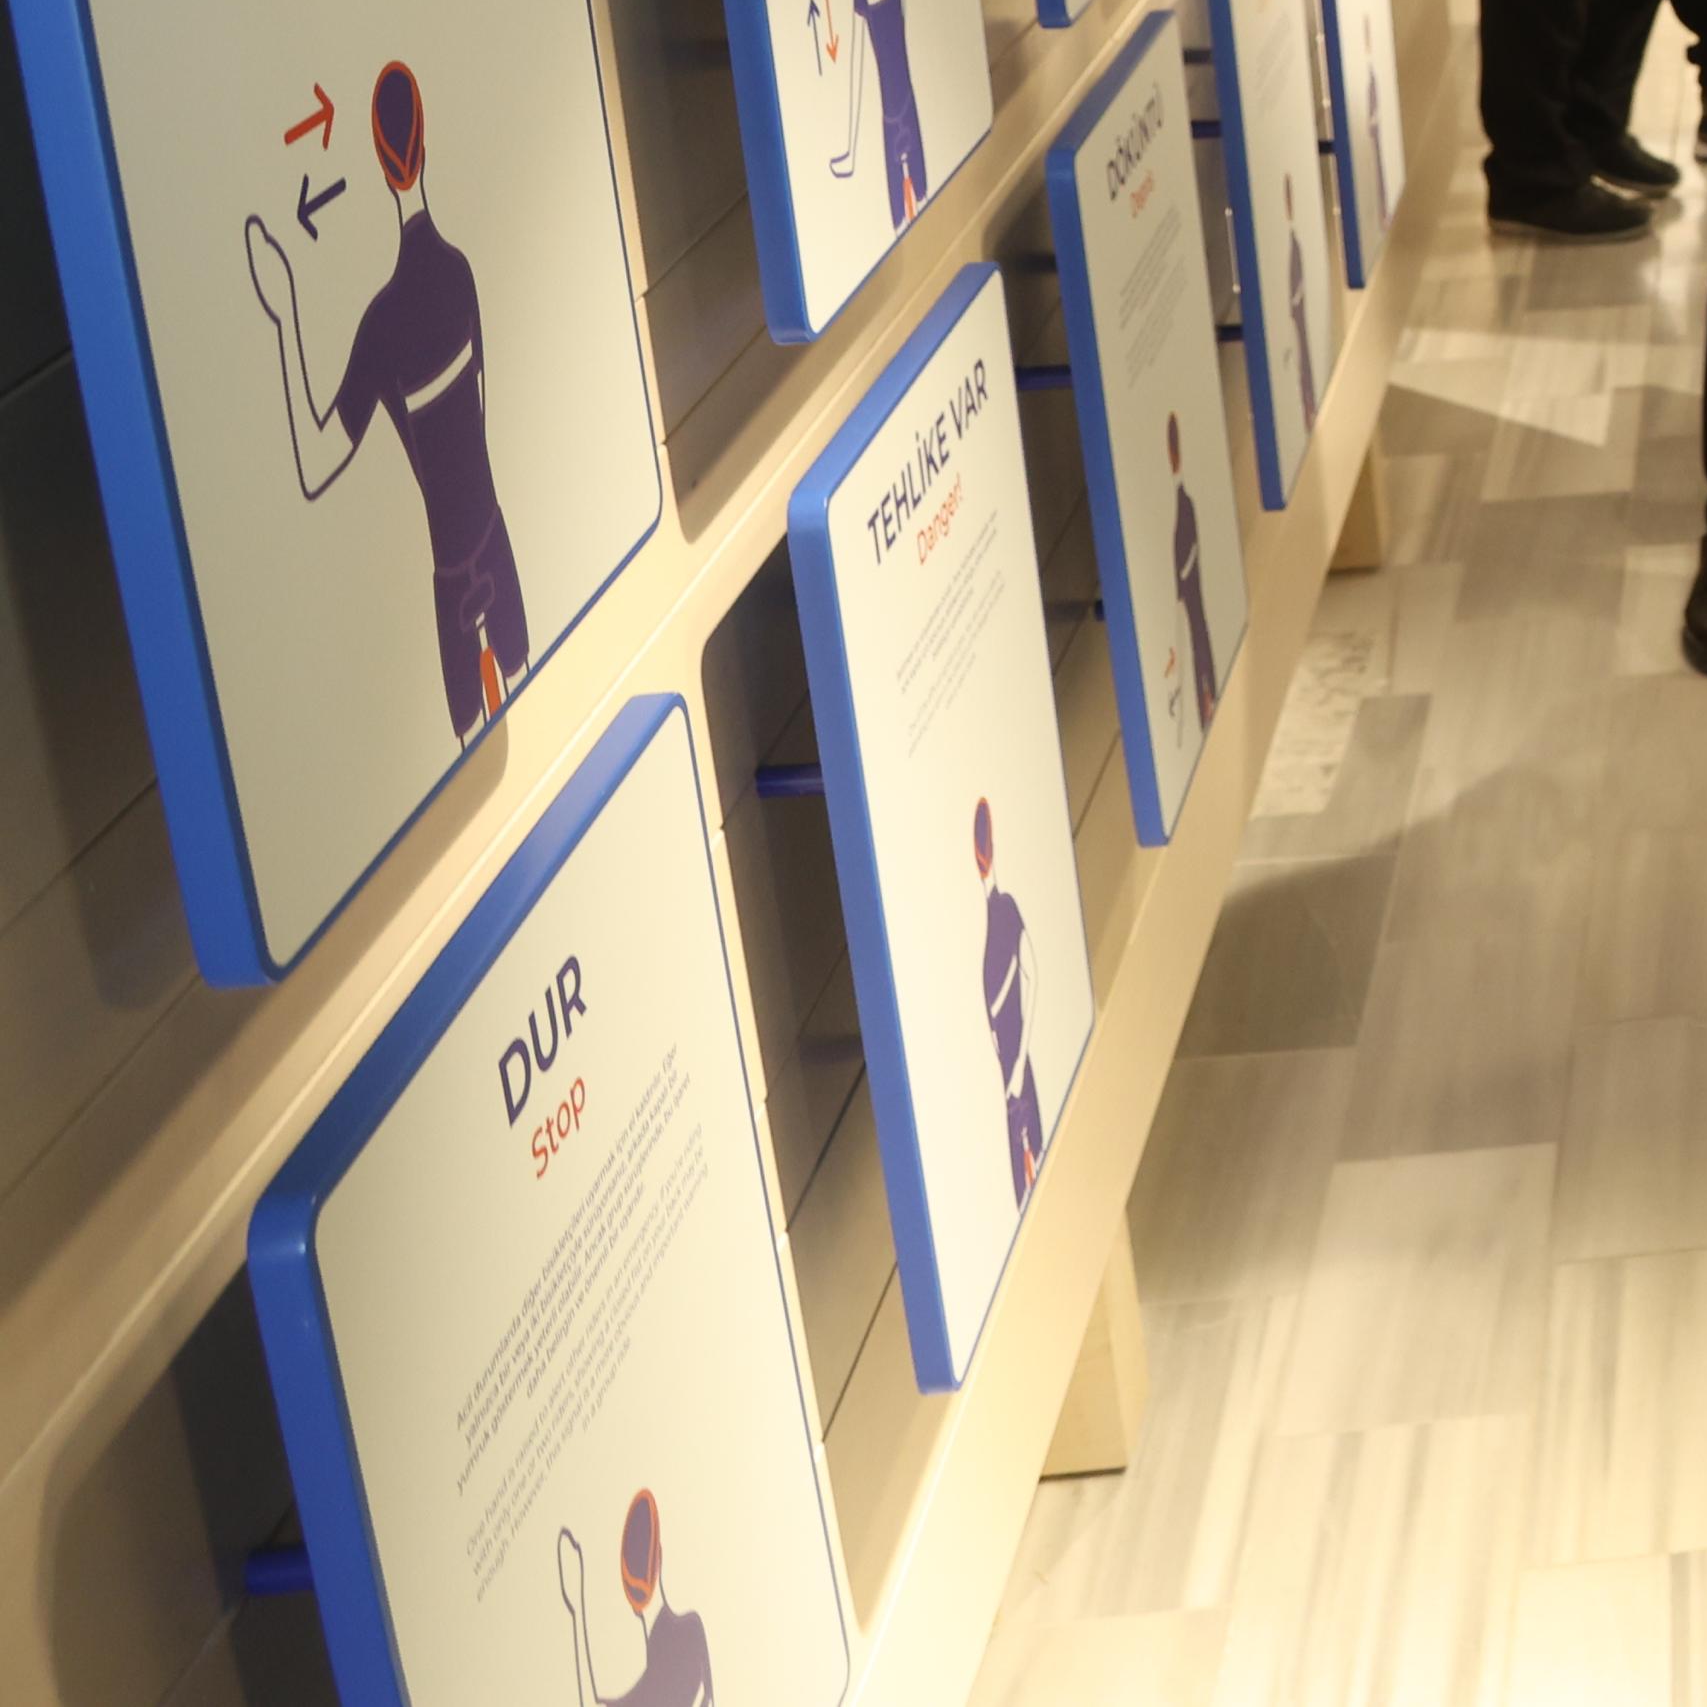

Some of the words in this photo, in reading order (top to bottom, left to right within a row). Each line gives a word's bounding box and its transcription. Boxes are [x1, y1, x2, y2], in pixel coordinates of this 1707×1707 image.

[867, 411, 951, 566] TEHLİKE
[949, 358, 989, 441] VAR
[498, 955, 588, 1129] DUR
[531, 1076, 586, 1180] Stop
